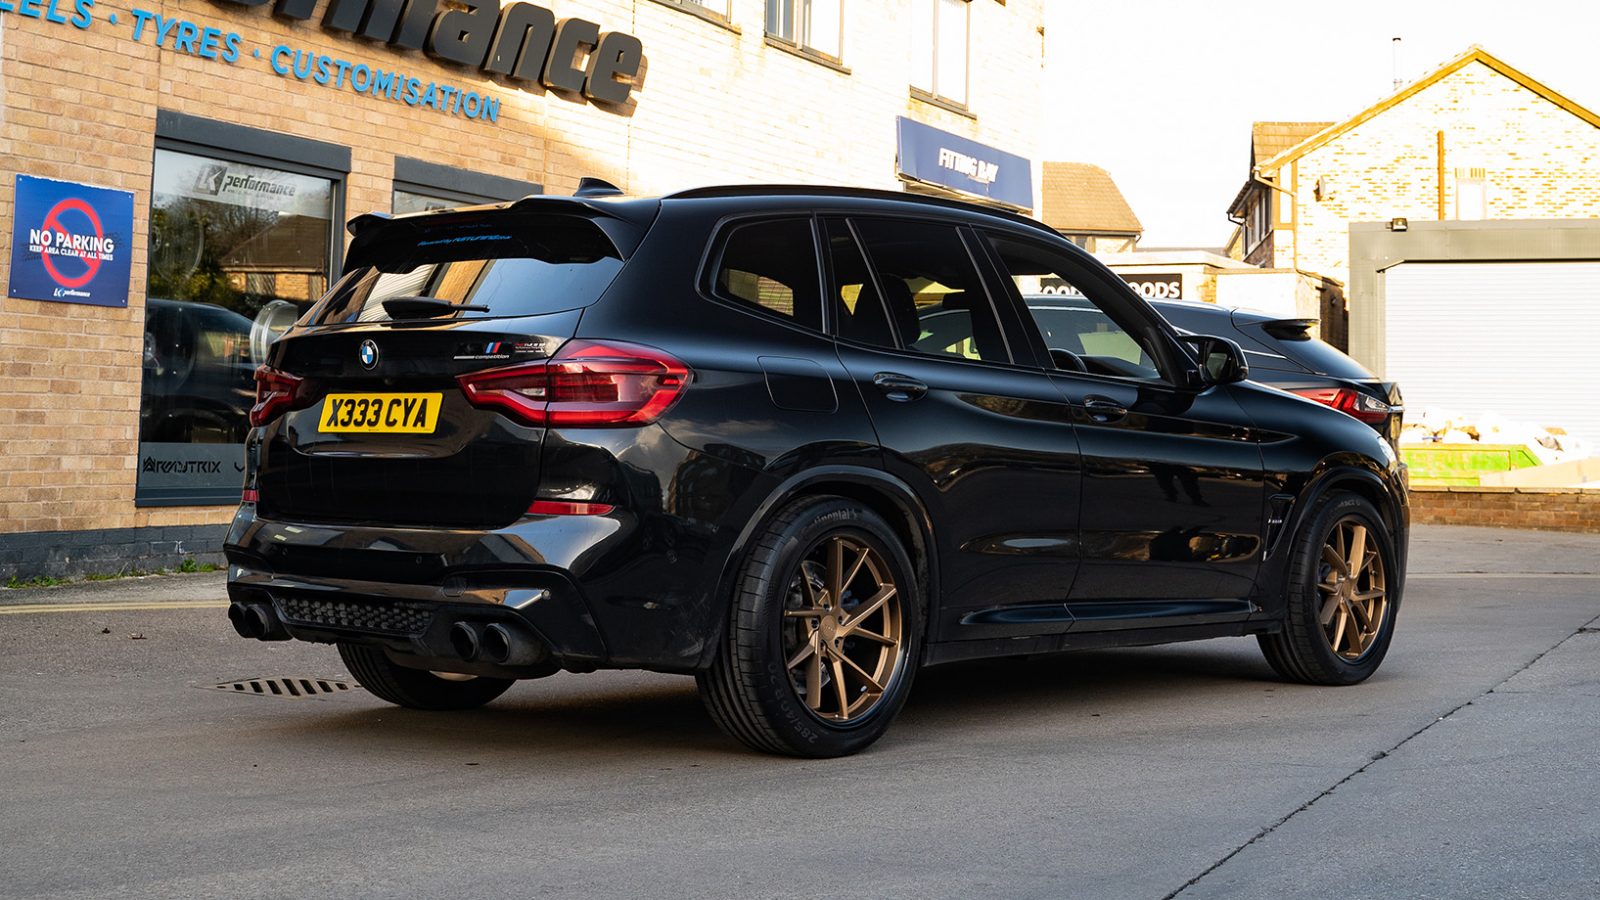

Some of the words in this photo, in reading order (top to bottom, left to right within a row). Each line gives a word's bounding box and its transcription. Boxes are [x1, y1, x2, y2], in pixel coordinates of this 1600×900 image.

[132, 8, 241, 63] TYRES
[271, 45, 500, 122] CUSTOMISATION
[222, 175, 296, 197] performance
[29, 228, 52, 246] NO
[56, 232, 115, 253] PARKING
[29, 245, 44, 253] KEEP
[44, 247, 59, 255] AREA
[60, 249, 79, 257] CLEAR
[79, 250, 87, 258] AT
[87, 251, 97, 259] ALL
[98, 252, 114, 261] TIMES
[326, 398, 383, 428] X333
[385, 398, 428, 428] CYA
